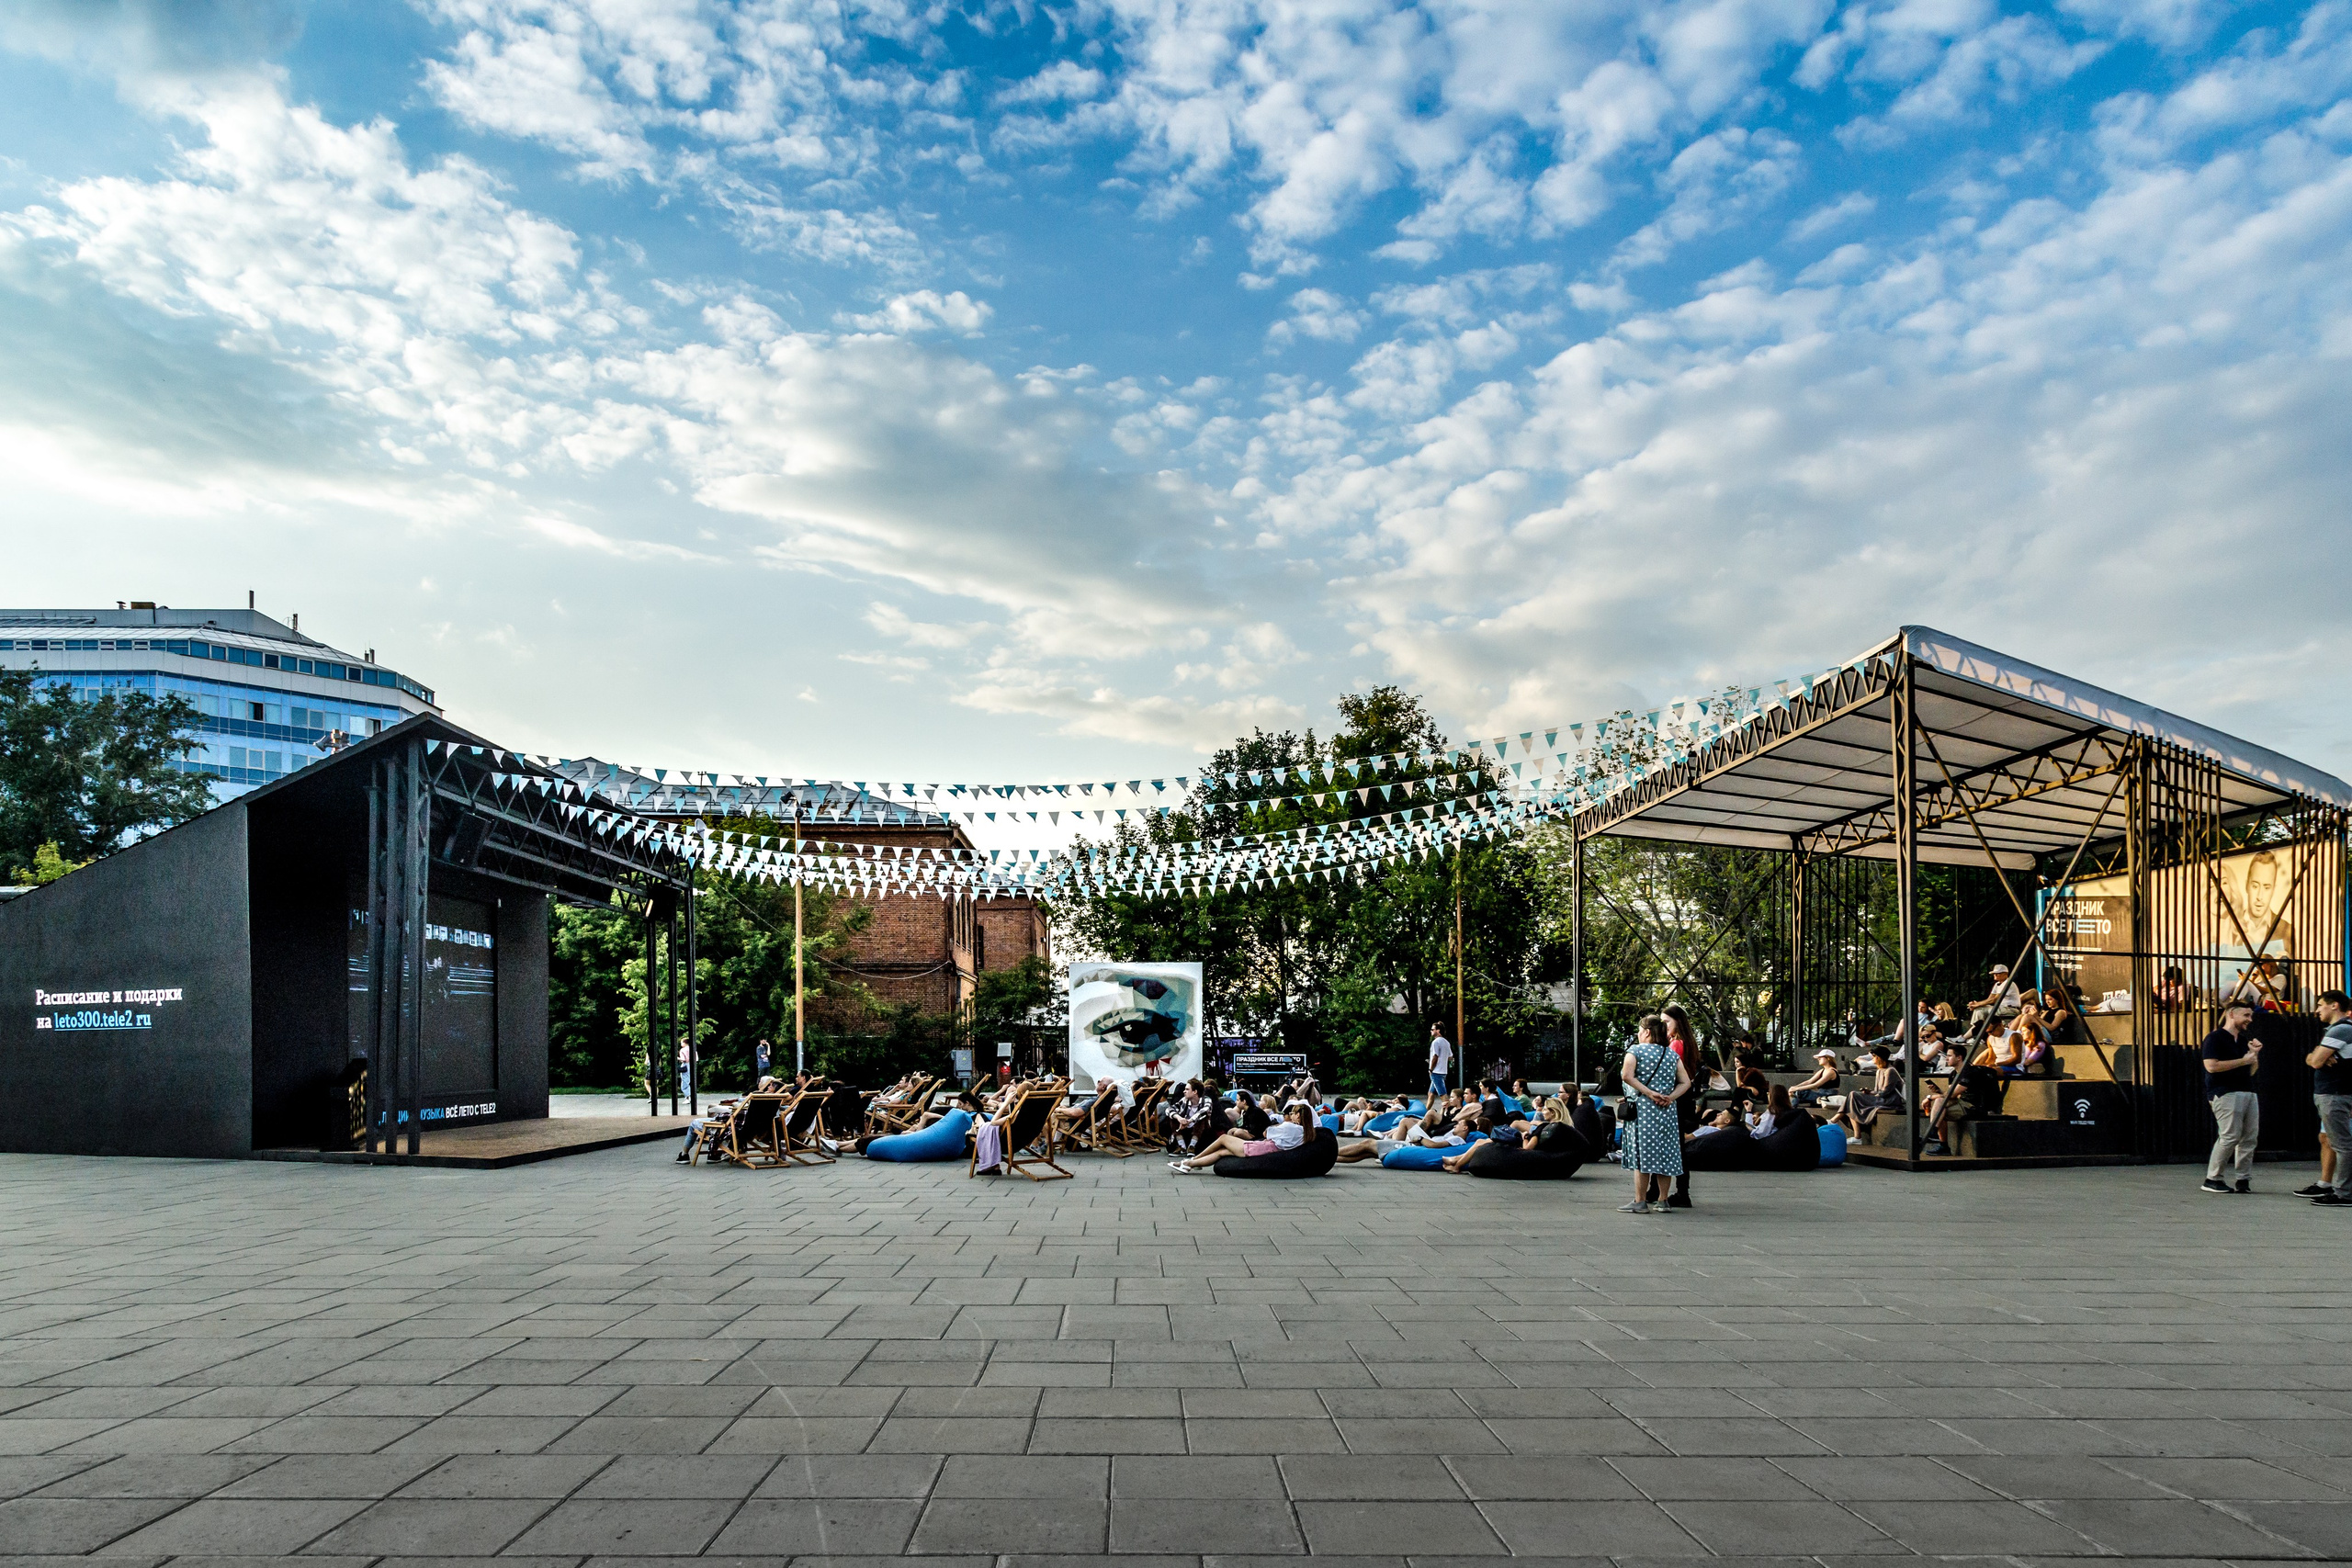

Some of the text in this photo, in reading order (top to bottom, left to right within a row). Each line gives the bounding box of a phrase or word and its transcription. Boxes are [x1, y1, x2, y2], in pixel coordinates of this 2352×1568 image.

[2045, 919, 2111, 934] ВСЕ ЛЕТО
[35, 988, 183, 1006] Расписание и подарки
[36, 1017, 52, 1029] на
[446, 1105, 458, 1119] ВСЁ
[458, 1104, 474, 1118] ЛЕТО
[480, 1102, 496, 1114] TELE2
